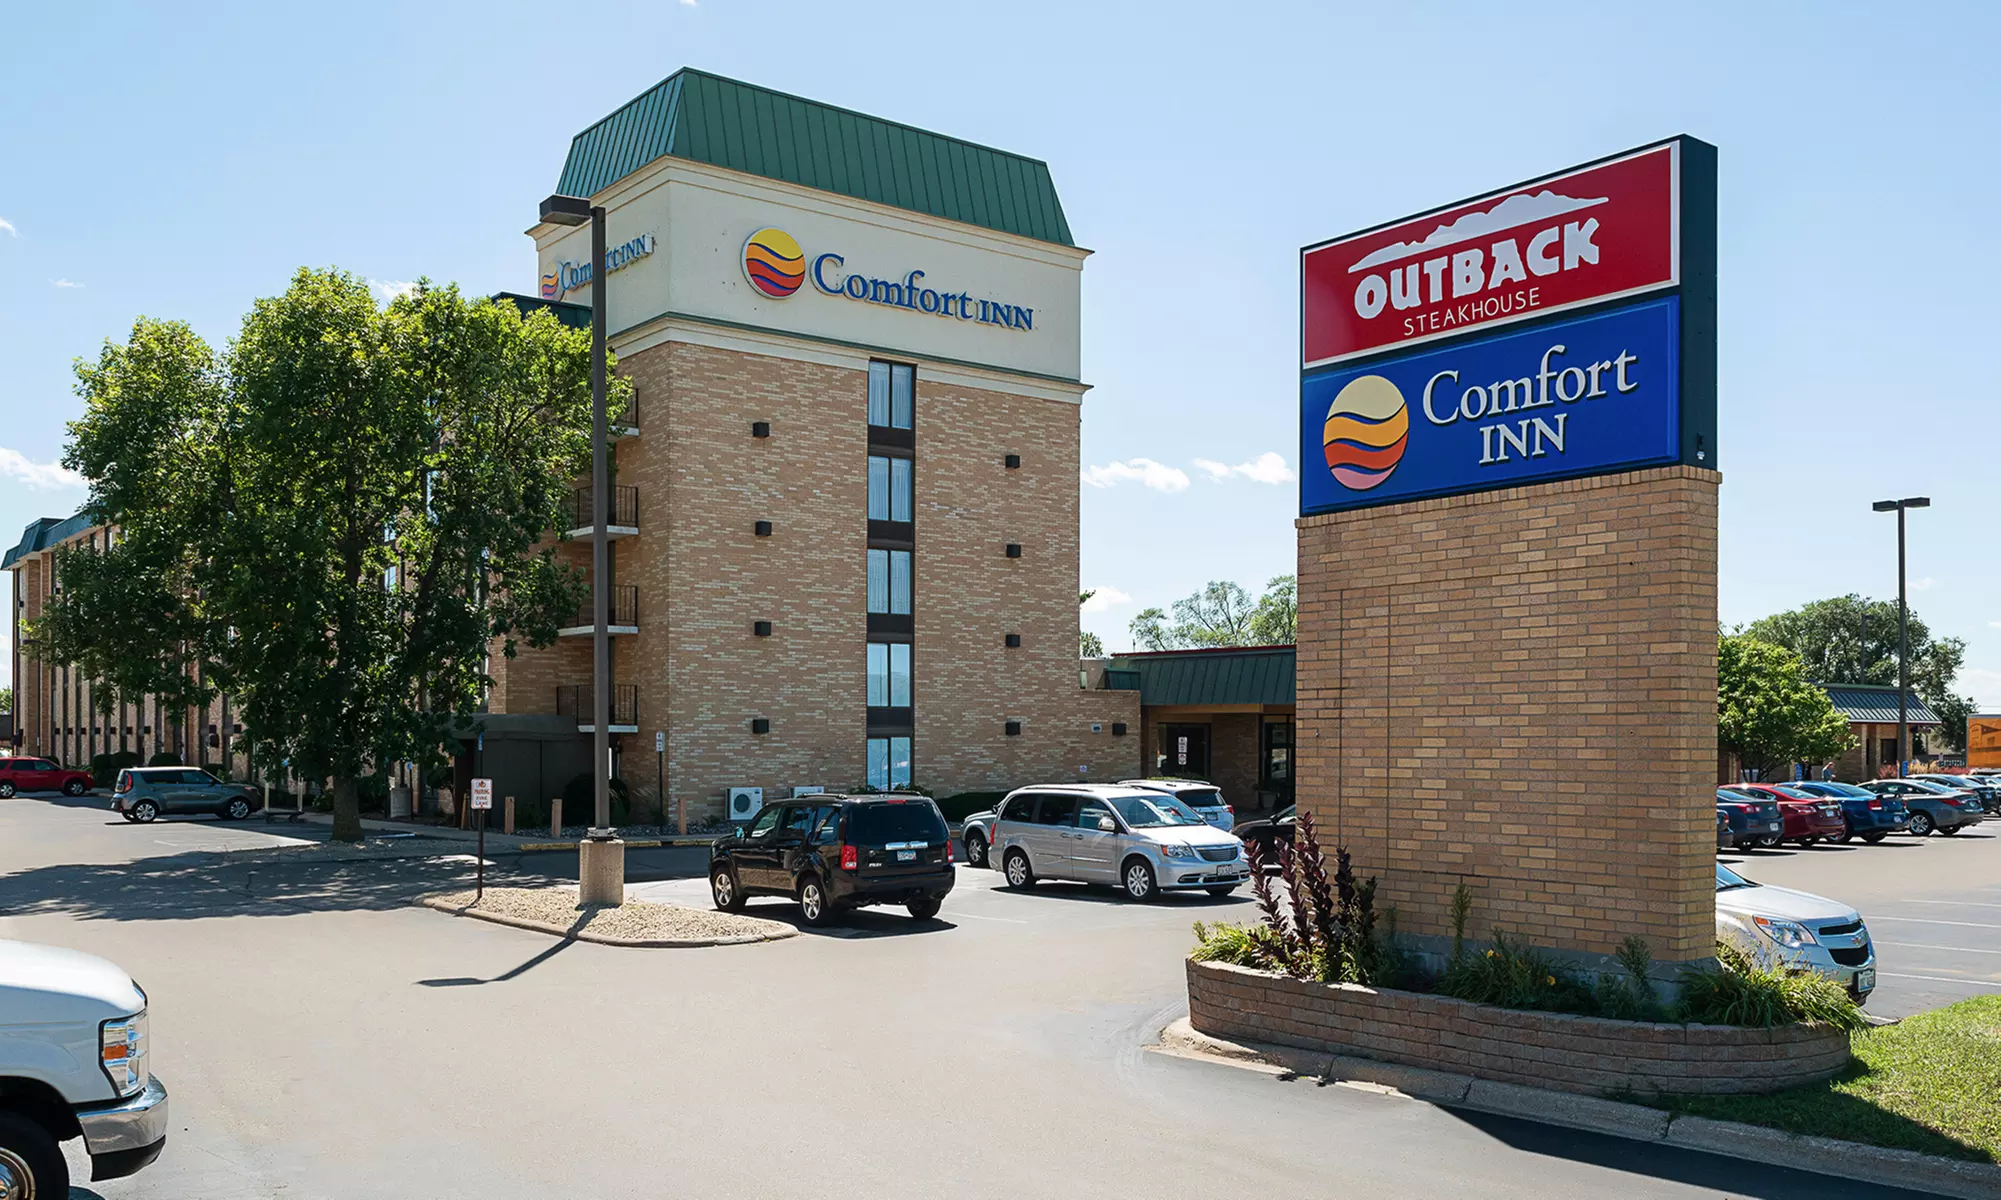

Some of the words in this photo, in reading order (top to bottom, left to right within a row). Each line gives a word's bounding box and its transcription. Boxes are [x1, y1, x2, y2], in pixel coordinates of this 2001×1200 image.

[561, 248, 620, 290] Comrt
[621, 234, 646, 264] INN
[811, 252, 974, 321] Comfort
[976, 299, 1034, 331] INN
[1354, 217, 1600, 319] OUTBACK
[1403, 286, 1541, 336] STEAKHOUSE
[1422, 344, 1638, 425] Comfort
[1478, 413, 1567, 464] INN
